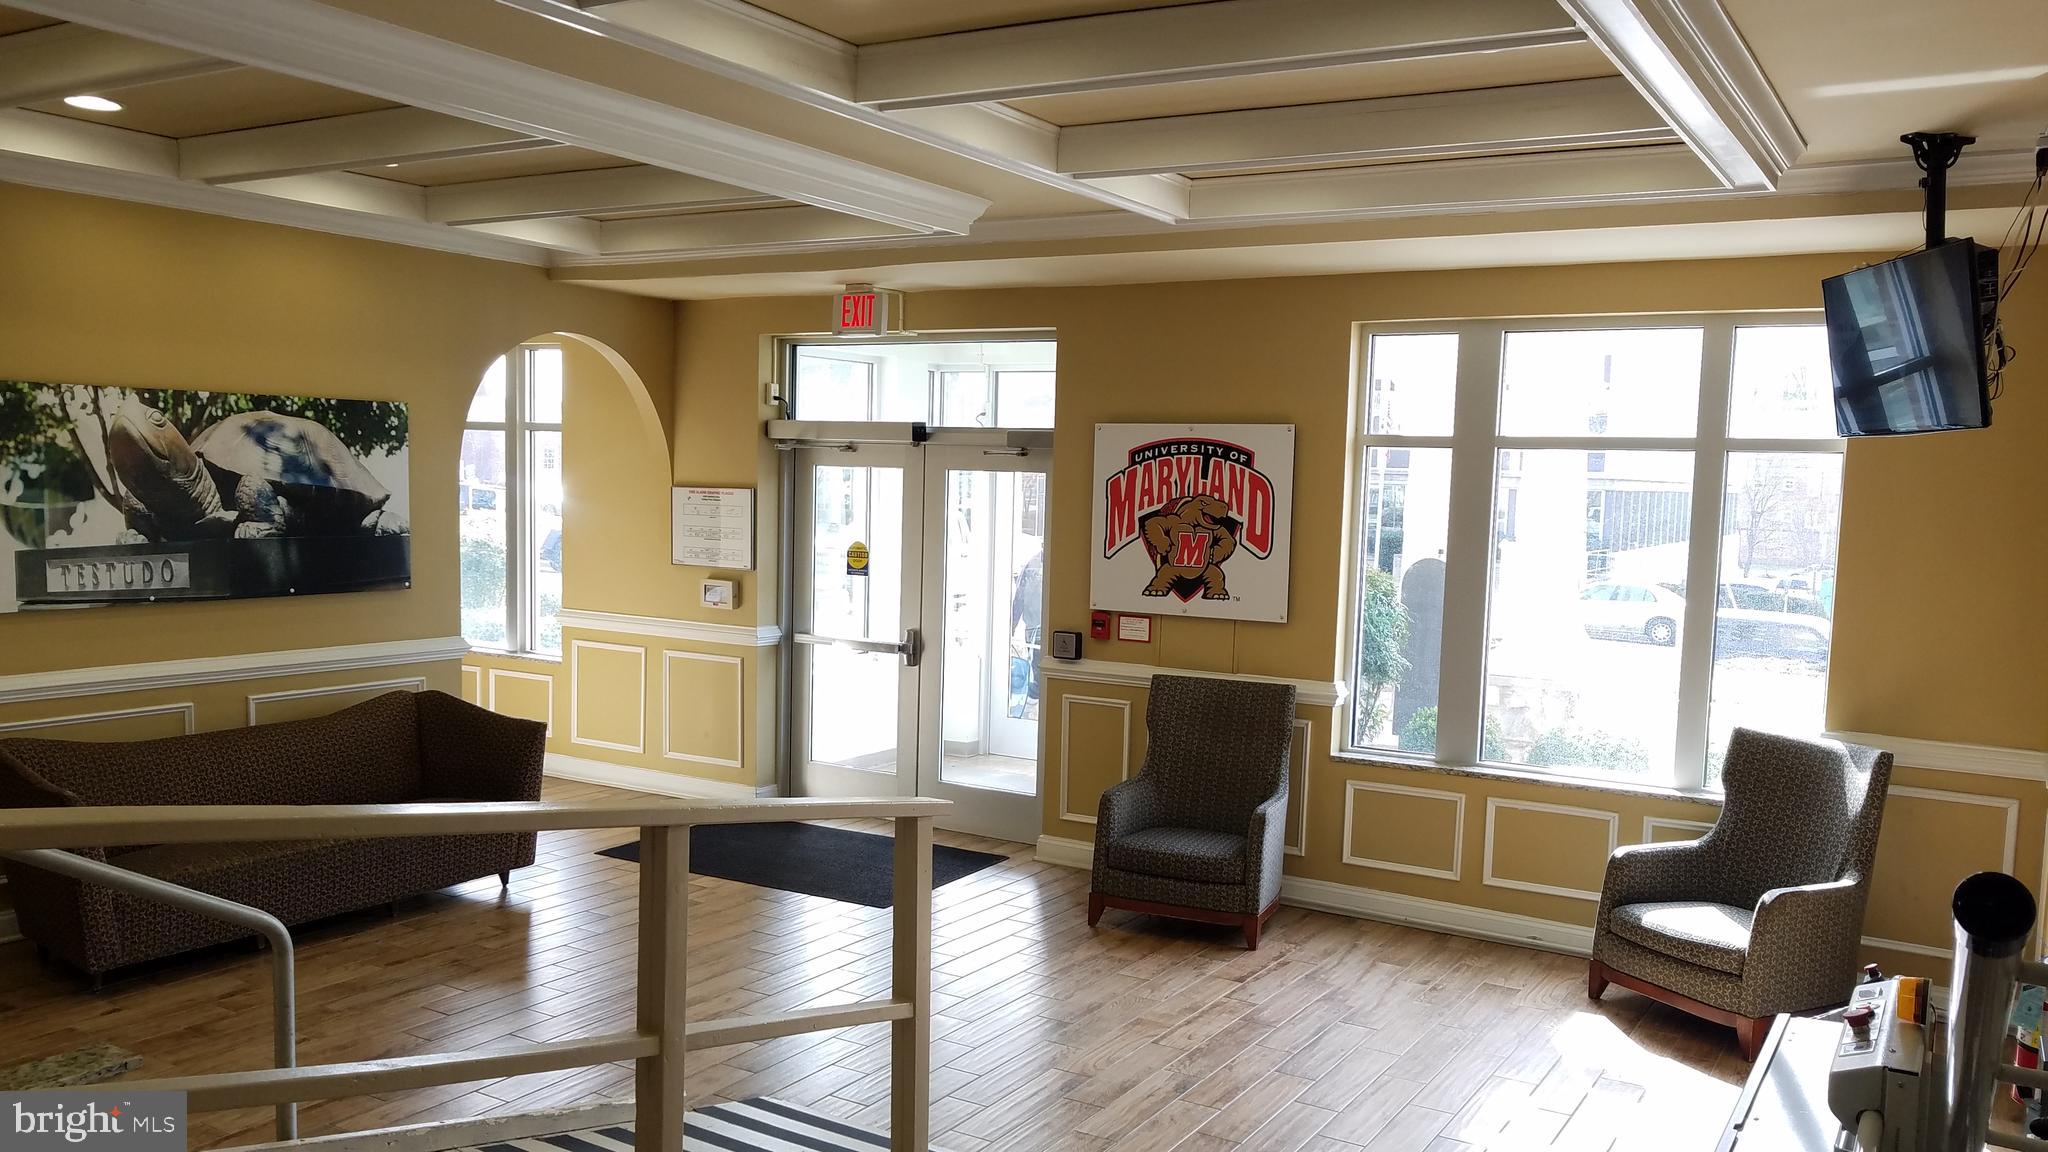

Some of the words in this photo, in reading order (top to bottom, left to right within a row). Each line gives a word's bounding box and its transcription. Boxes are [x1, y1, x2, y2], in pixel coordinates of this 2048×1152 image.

[841, 294, 875, 328] EXIT
[1134, 444, 1224, 462] UNIVERSITY
[1229, 451, 1249, 464] OF
[1106, 454, 1273, 555] MARYLAND
[1174, 532, 1209, 567] M
[59, 558, 176, 589] TESTUDO
